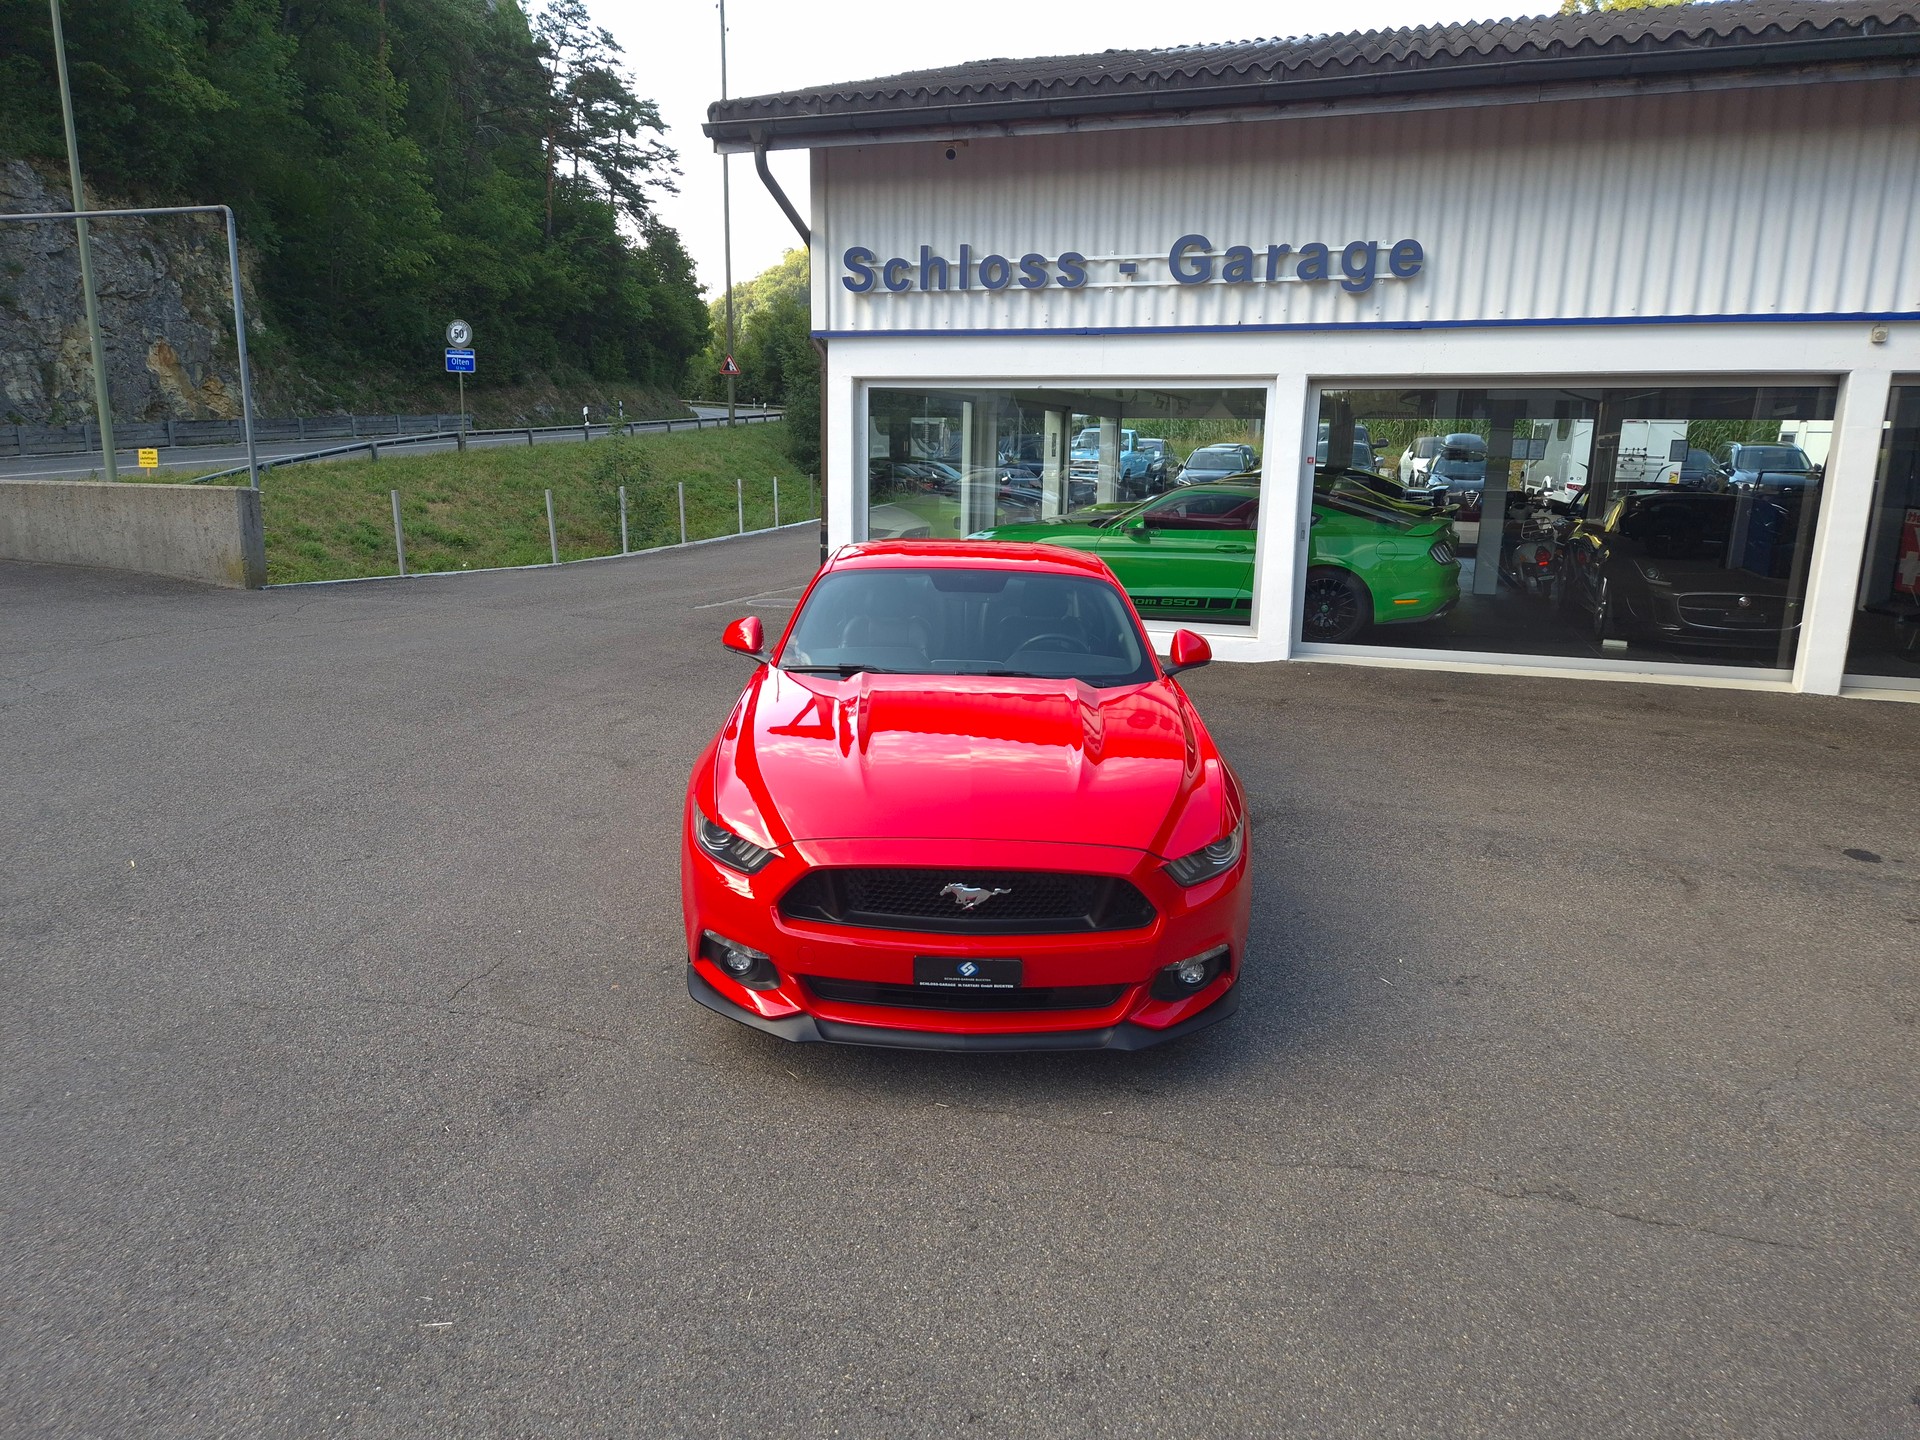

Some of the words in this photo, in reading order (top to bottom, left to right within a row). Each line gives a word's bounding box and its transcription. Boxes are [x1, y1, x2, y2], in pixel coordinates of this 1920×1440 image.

[842, 244, 1087, 293] Schloss
[1168, 233, 1424, 293] Garage
[454, 328, 464, 339] 50
[451, 357, 470, 366] Olten
[1160, 598, 1199, 606] 850
